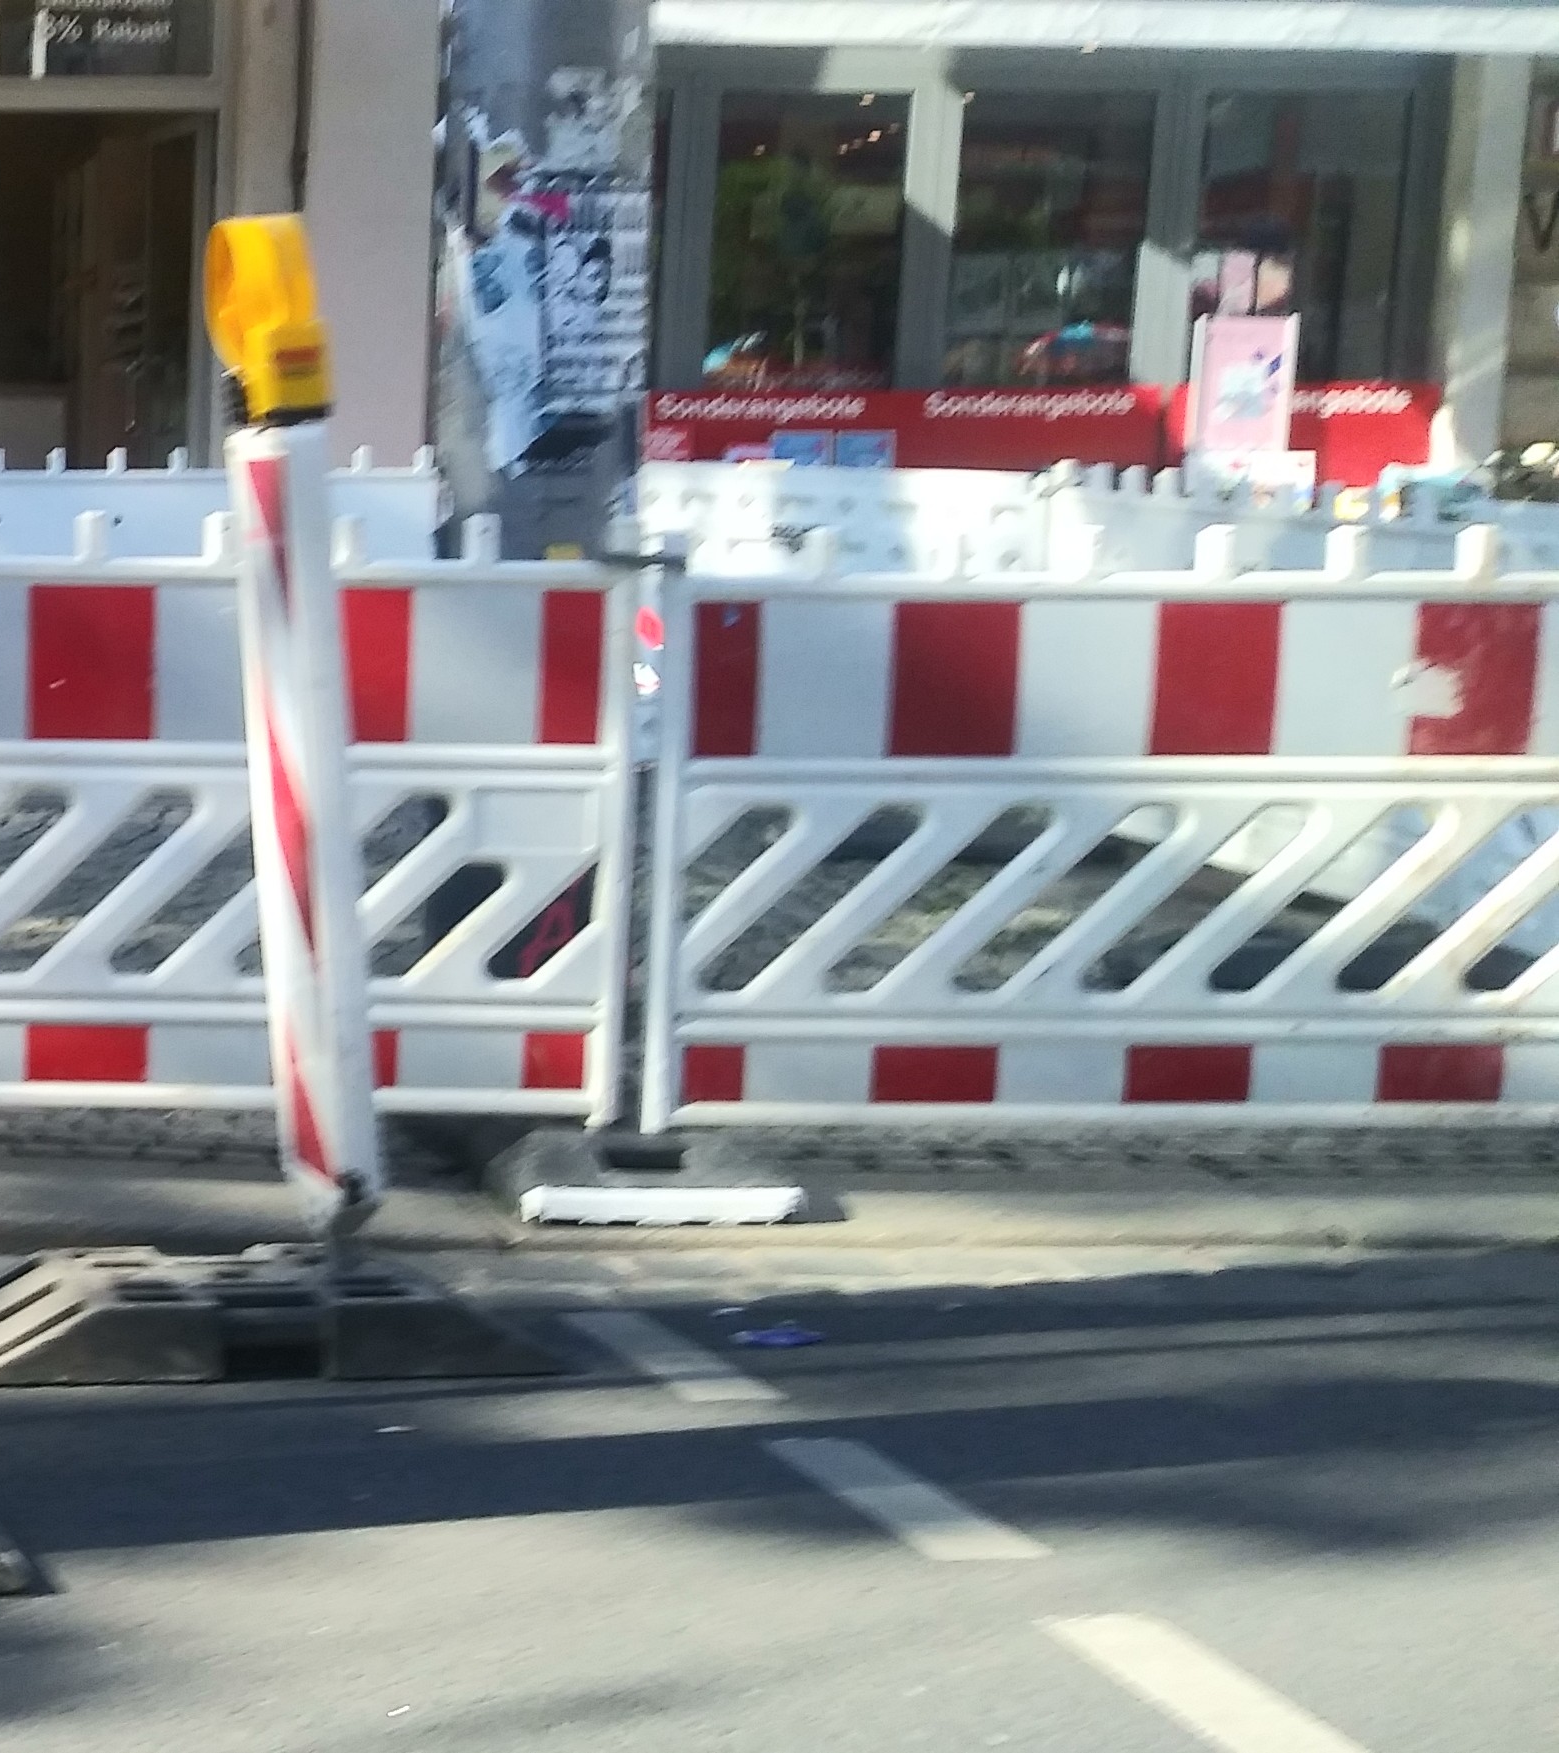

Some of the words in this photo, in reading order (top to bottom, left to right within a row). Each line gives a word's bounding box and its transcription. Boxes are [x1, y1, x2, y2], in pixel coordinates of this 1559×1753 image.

[655, 393, 867, 424] Sonderangebote
[925, 388, 1133, 422] Sonderangebote
[1291, 384, 1413, 419] angebote
